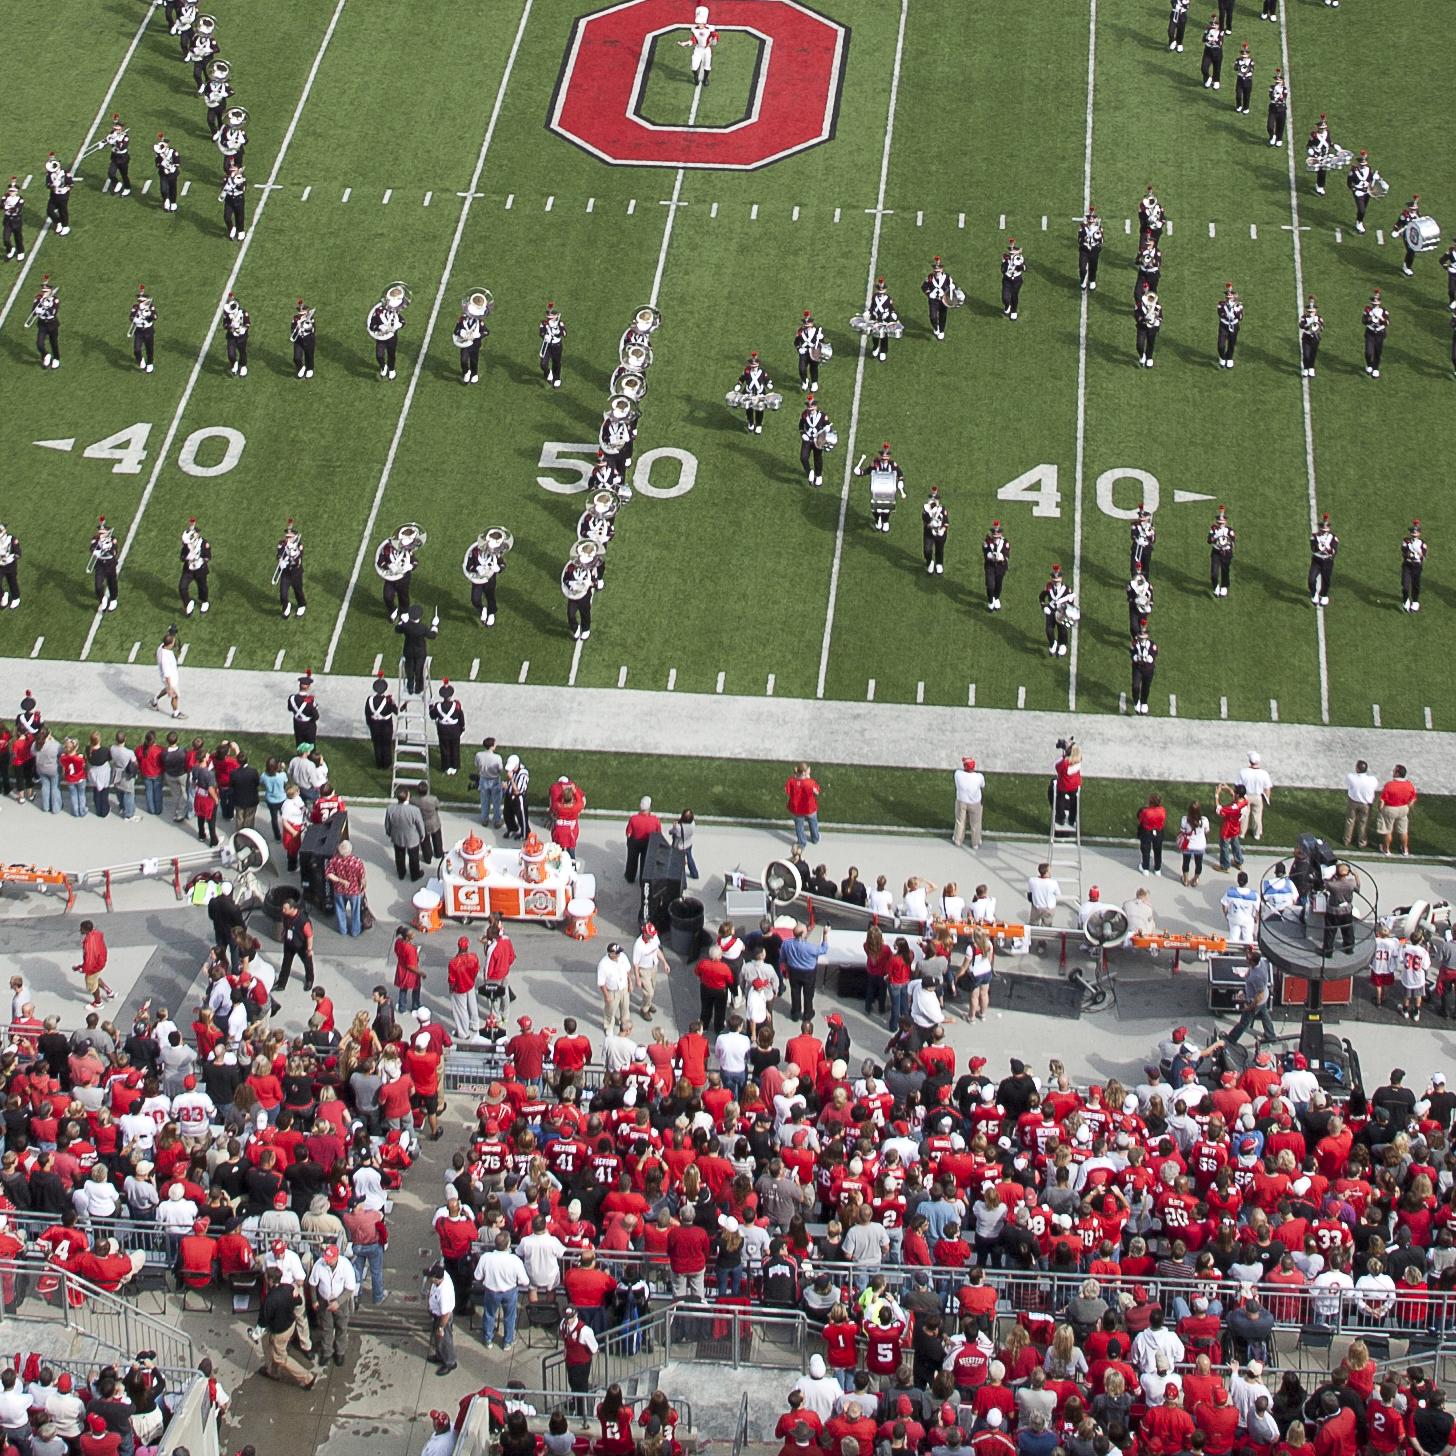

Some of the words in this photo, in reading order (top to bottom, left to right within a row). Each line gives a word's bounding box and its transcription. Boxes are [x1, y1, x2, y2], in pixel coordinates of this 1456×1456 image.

[82, 422, 247, 477] 40
[536, 441, 699, 499] 50
[997, 463, 1160, 519] 40
[977, 1120, 999, 1136] 45
[481, 1155, 501, 1169] 76
[556, 1153, 574, 1172] 41
[595, 1165, 613, 1183] 41
[884, 1210, 897, 1227] 2
[1317, 1229, 1342, 1246] 33
[54, 1239, 71, 1261] 4
[877, 1343, 893, 1362] 5
[606, 1421, 619, 1440] 2
